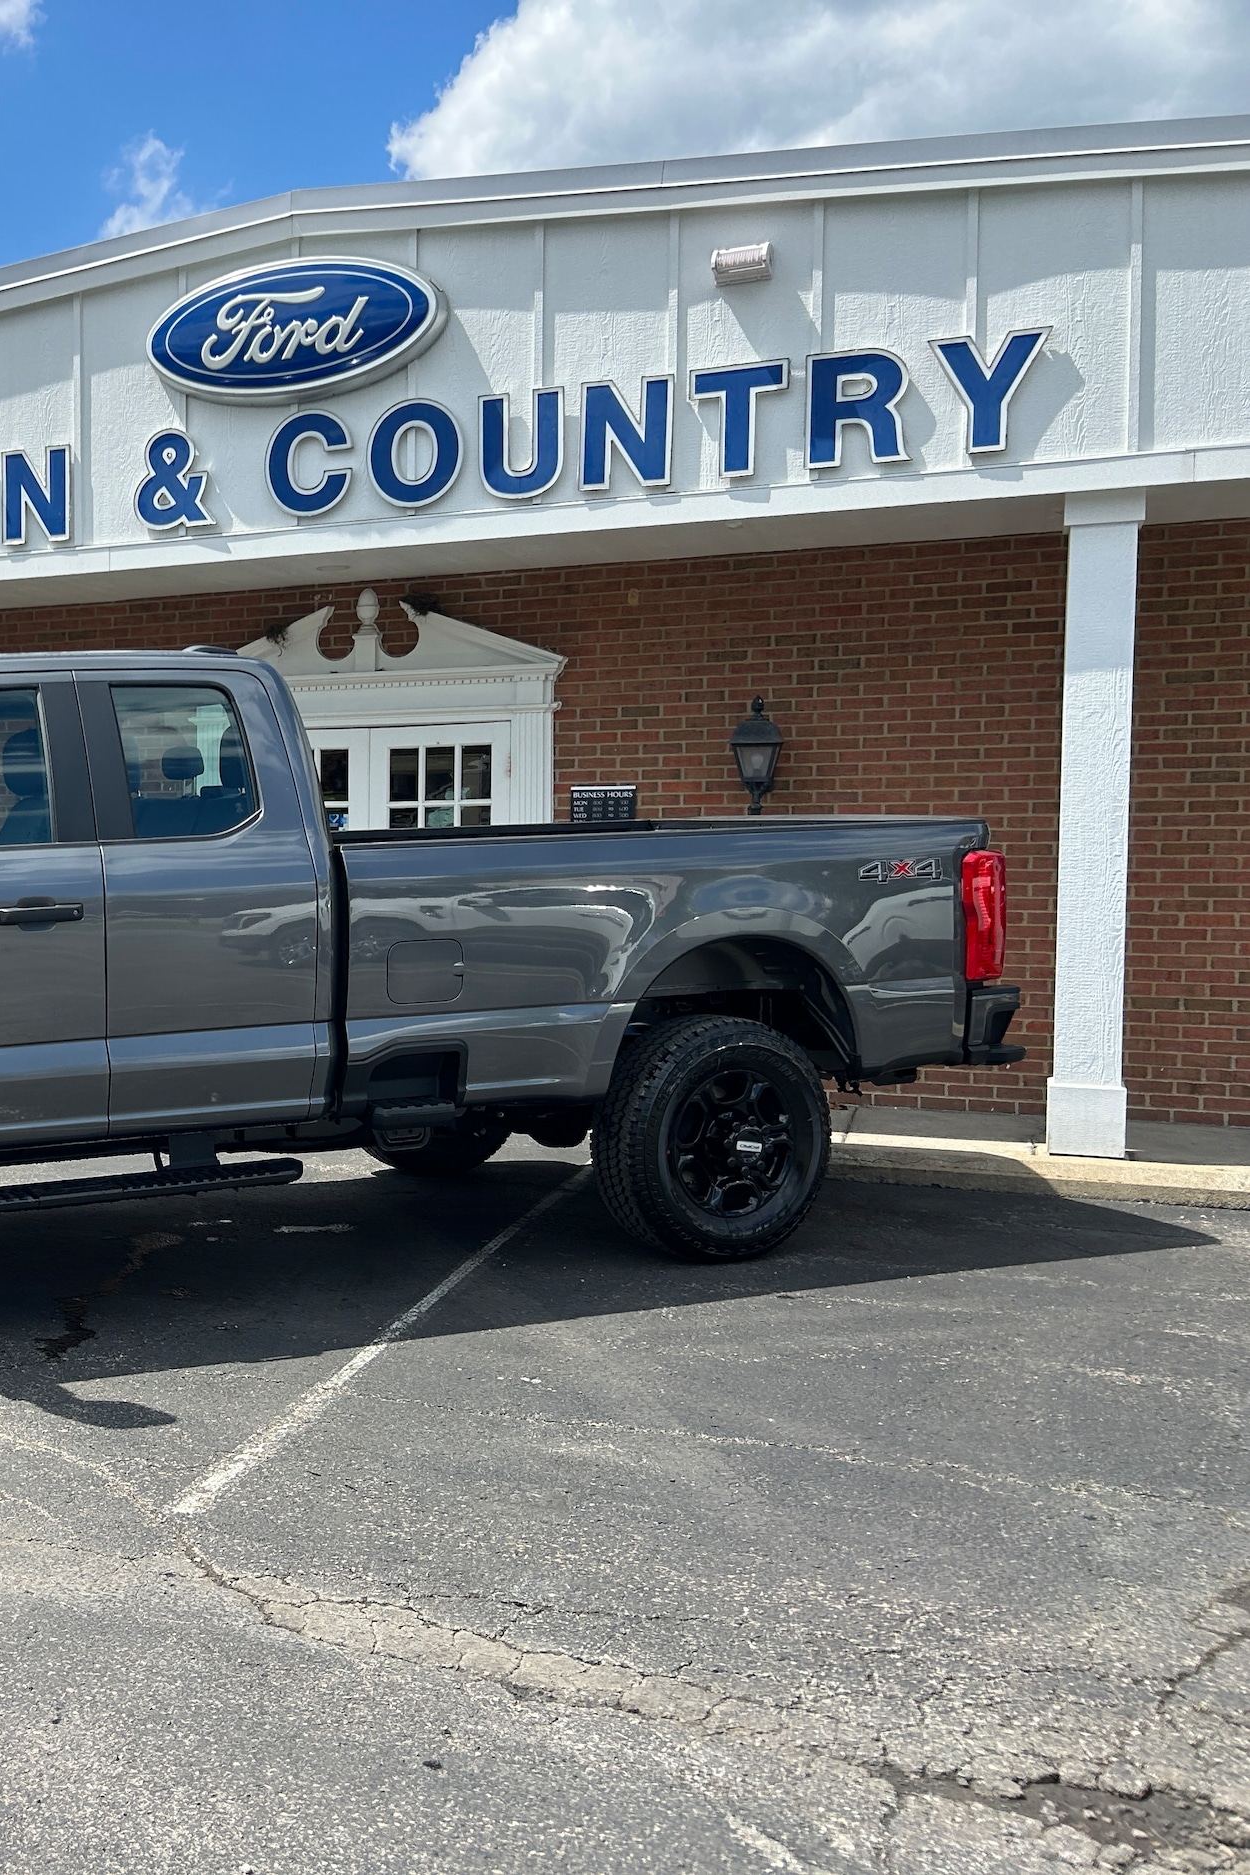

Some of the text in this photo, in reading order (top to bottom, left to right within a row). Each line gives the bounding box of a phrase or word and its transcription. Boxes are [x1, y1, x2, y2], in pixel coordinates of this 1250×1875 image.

[200, 285, 370, 371] Ford
[133, 427, 217, 531] &
[264, 325, 1054, 517] COUNTRY
